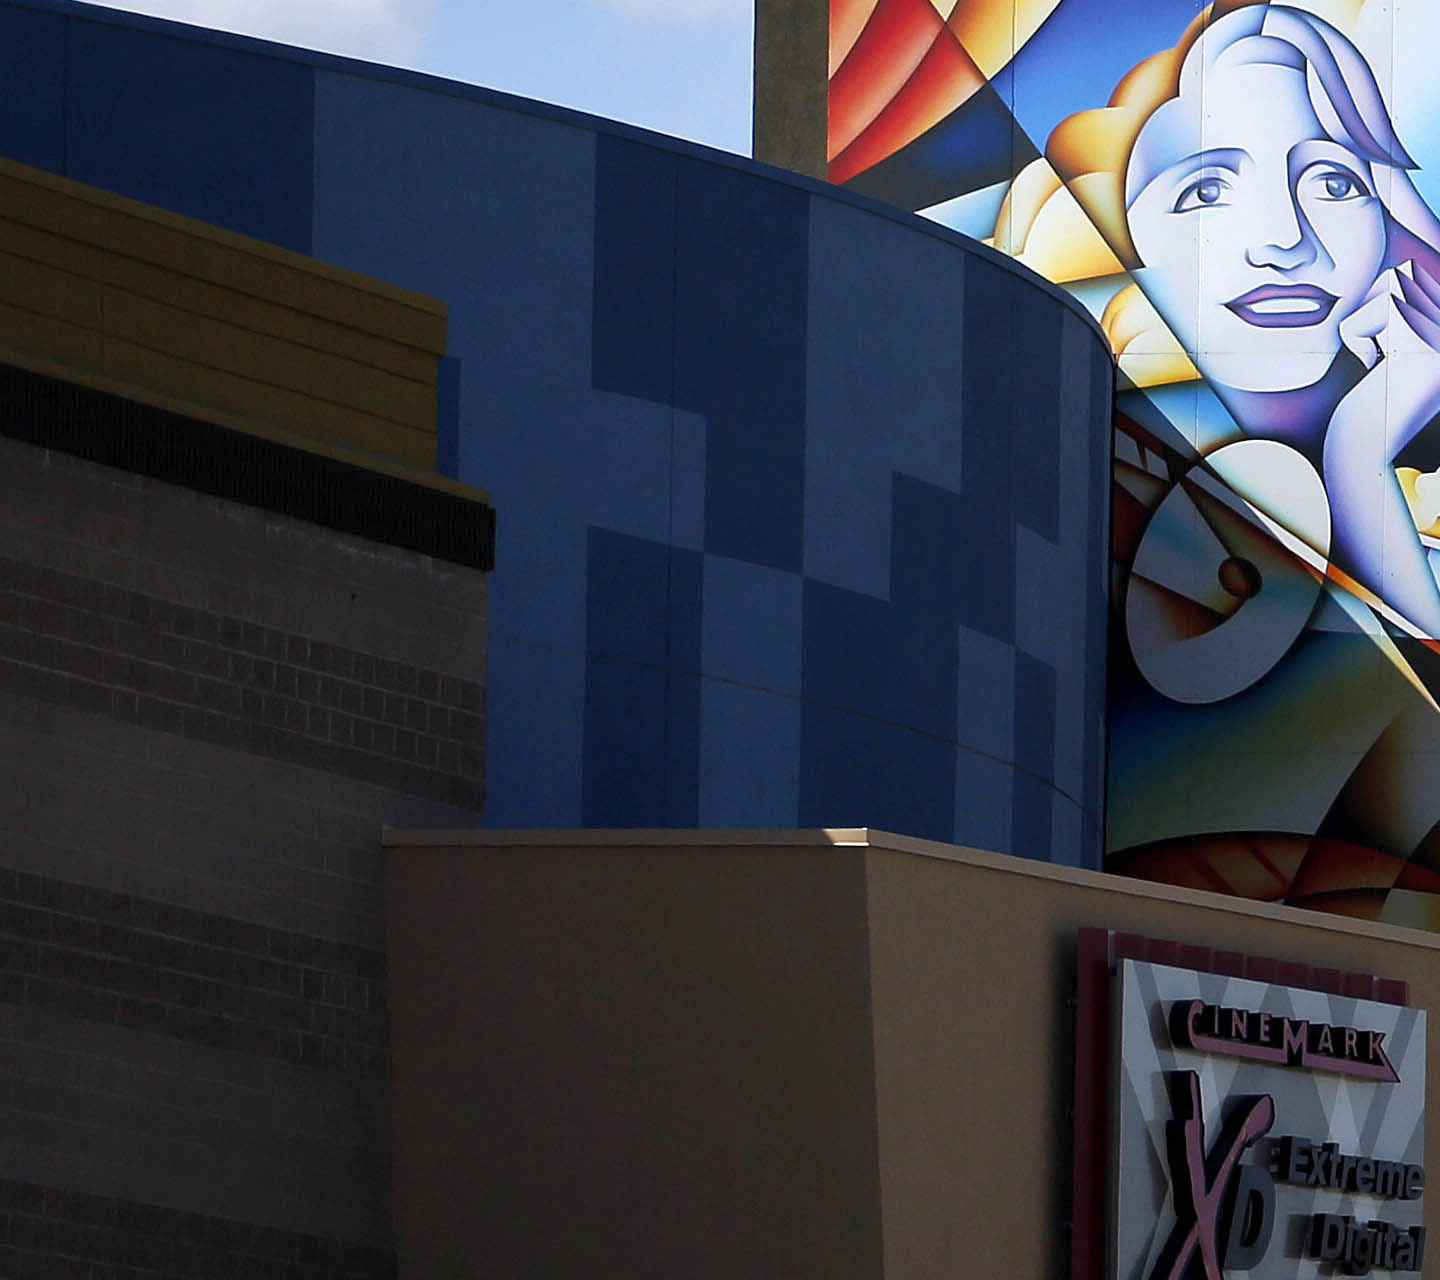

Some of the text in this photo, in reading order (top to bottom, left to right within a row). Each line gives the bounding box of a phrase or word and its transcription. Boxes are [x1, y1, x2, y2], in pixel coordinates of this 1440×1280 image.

[1180, 999, 1399, 1081] CINEMARK
[1283, 1136, 1424, 1200] Extreme
[1316, 1214, 1425, 1276] Digital
